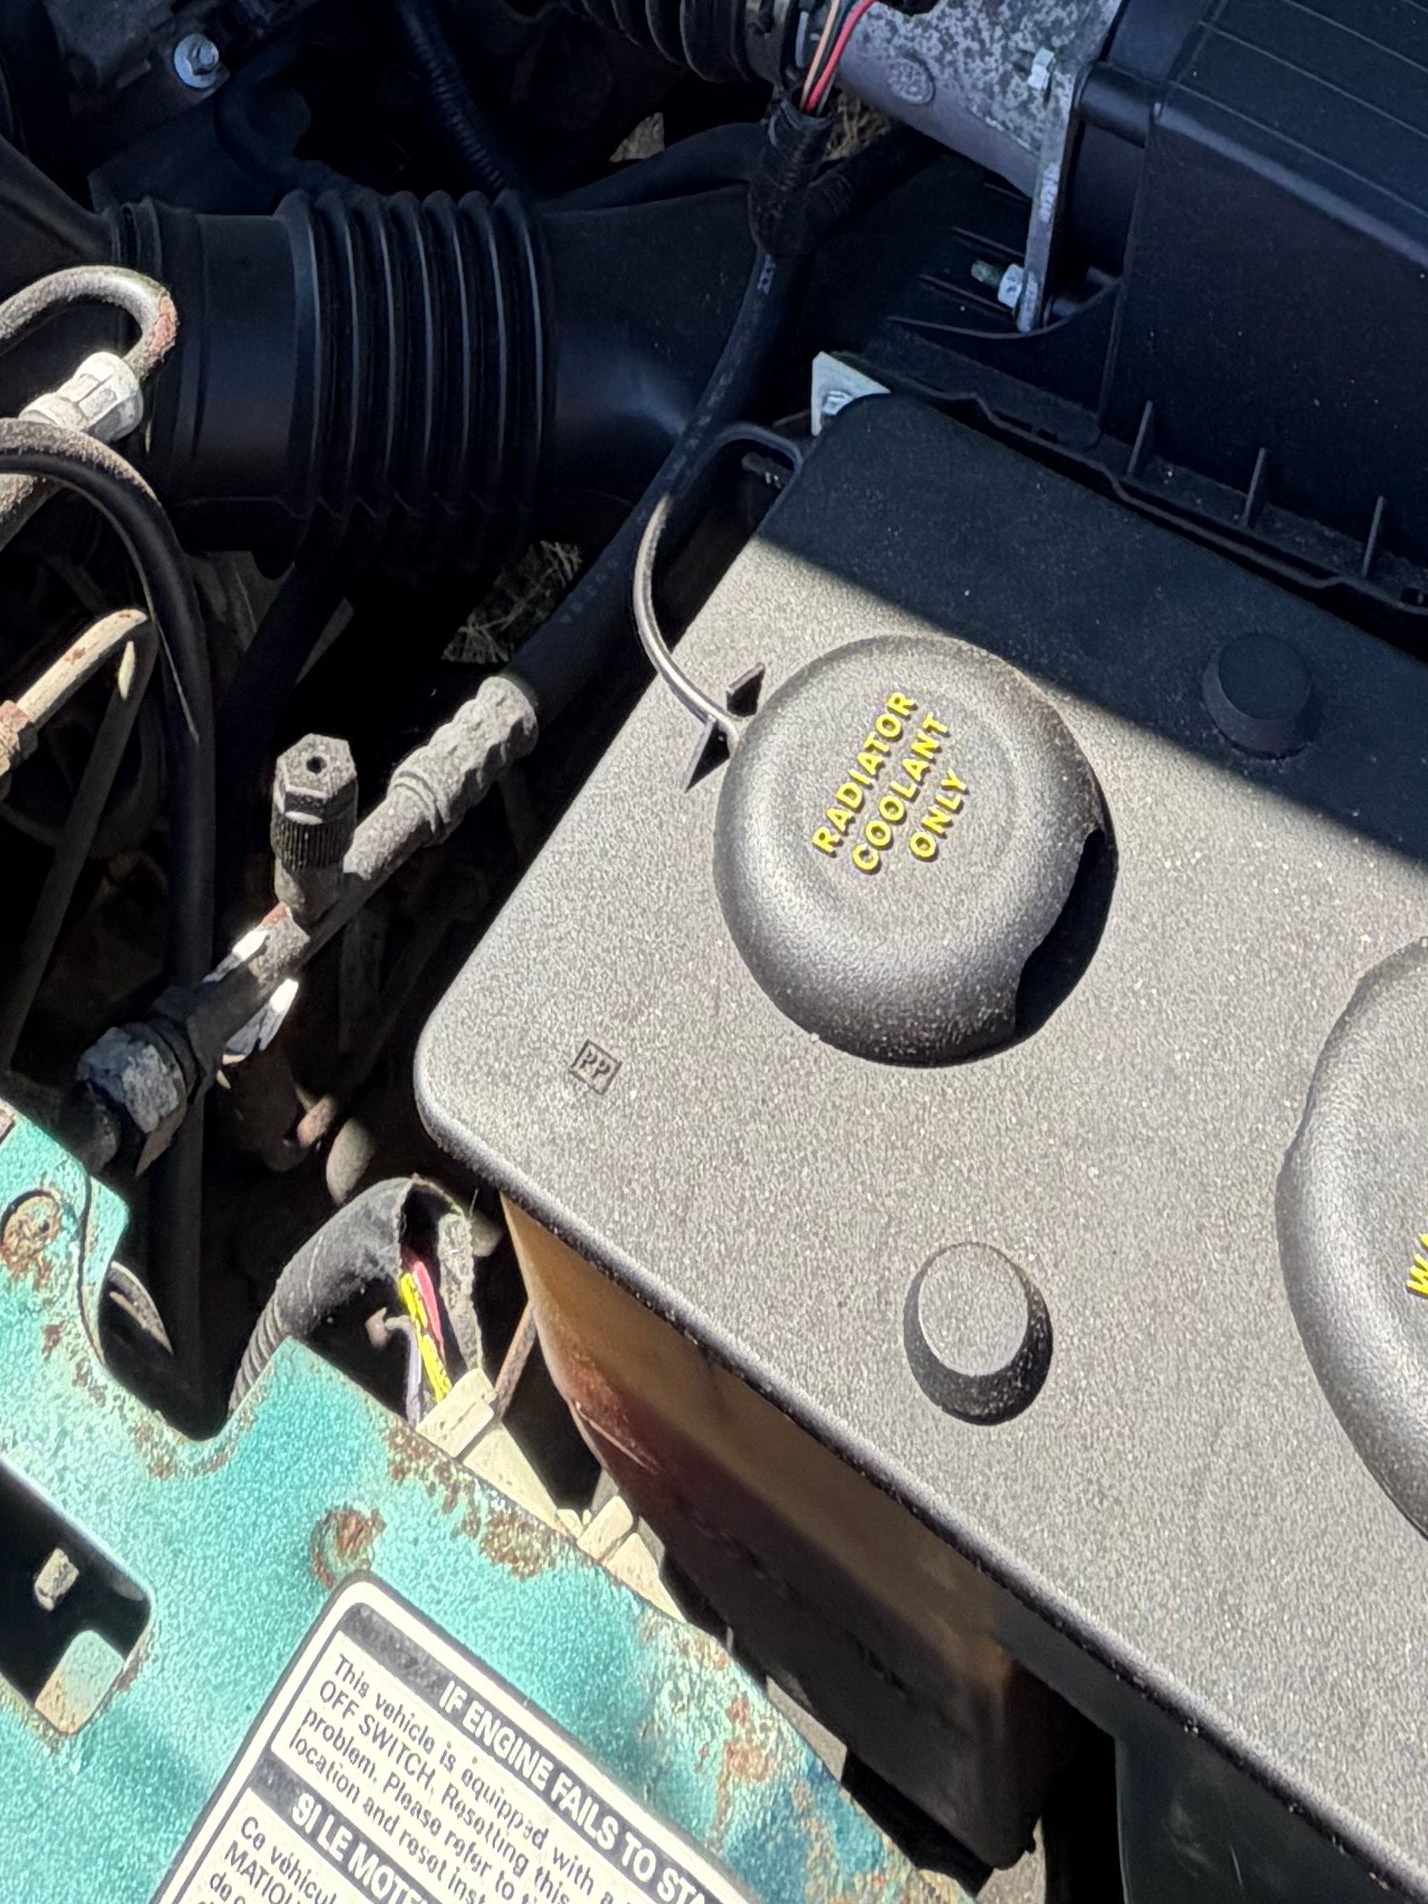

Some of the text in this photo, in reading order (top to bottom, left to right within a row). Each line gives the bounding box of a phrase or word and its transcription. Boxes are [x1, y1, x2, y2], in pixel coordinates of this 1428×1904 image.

[812, 692, 917, 854] RADIATOR
[852, 712, 949, 875] COOLANT
[911, 768, 969, 862] ONLY
[241, 1817, 265, 1851] Ce
[289, 1727, 360, 1803] location
[363, 1797, 400, 1836] and
[399, 1829, 447, 1881] reset
[292, 1793, 322, 1833] SI
[317, 1815, 353, 1862] LE
[299, 1706, 514, 1900] problem. Please refer to
[320, 1680, 359, 1719] OFF
[440, 1782, 532, 1877] Resetting
[535, 1866, 569, 1904] this
[335, 1654, 369, 1698] This
[376, 1693, 435, 1754] vehicle
[440, 1742, 456, 1772] is
[461, 1768, 550, 1851] equipped
[553, 1847, 593, 1895] with
[439, 1680, 467, 1713] IF
[463, 1700, 553, 1791] ENGINE
[549, 1775, 619, 1851] FAILS
[622, 1832, 656, 1882] TO
